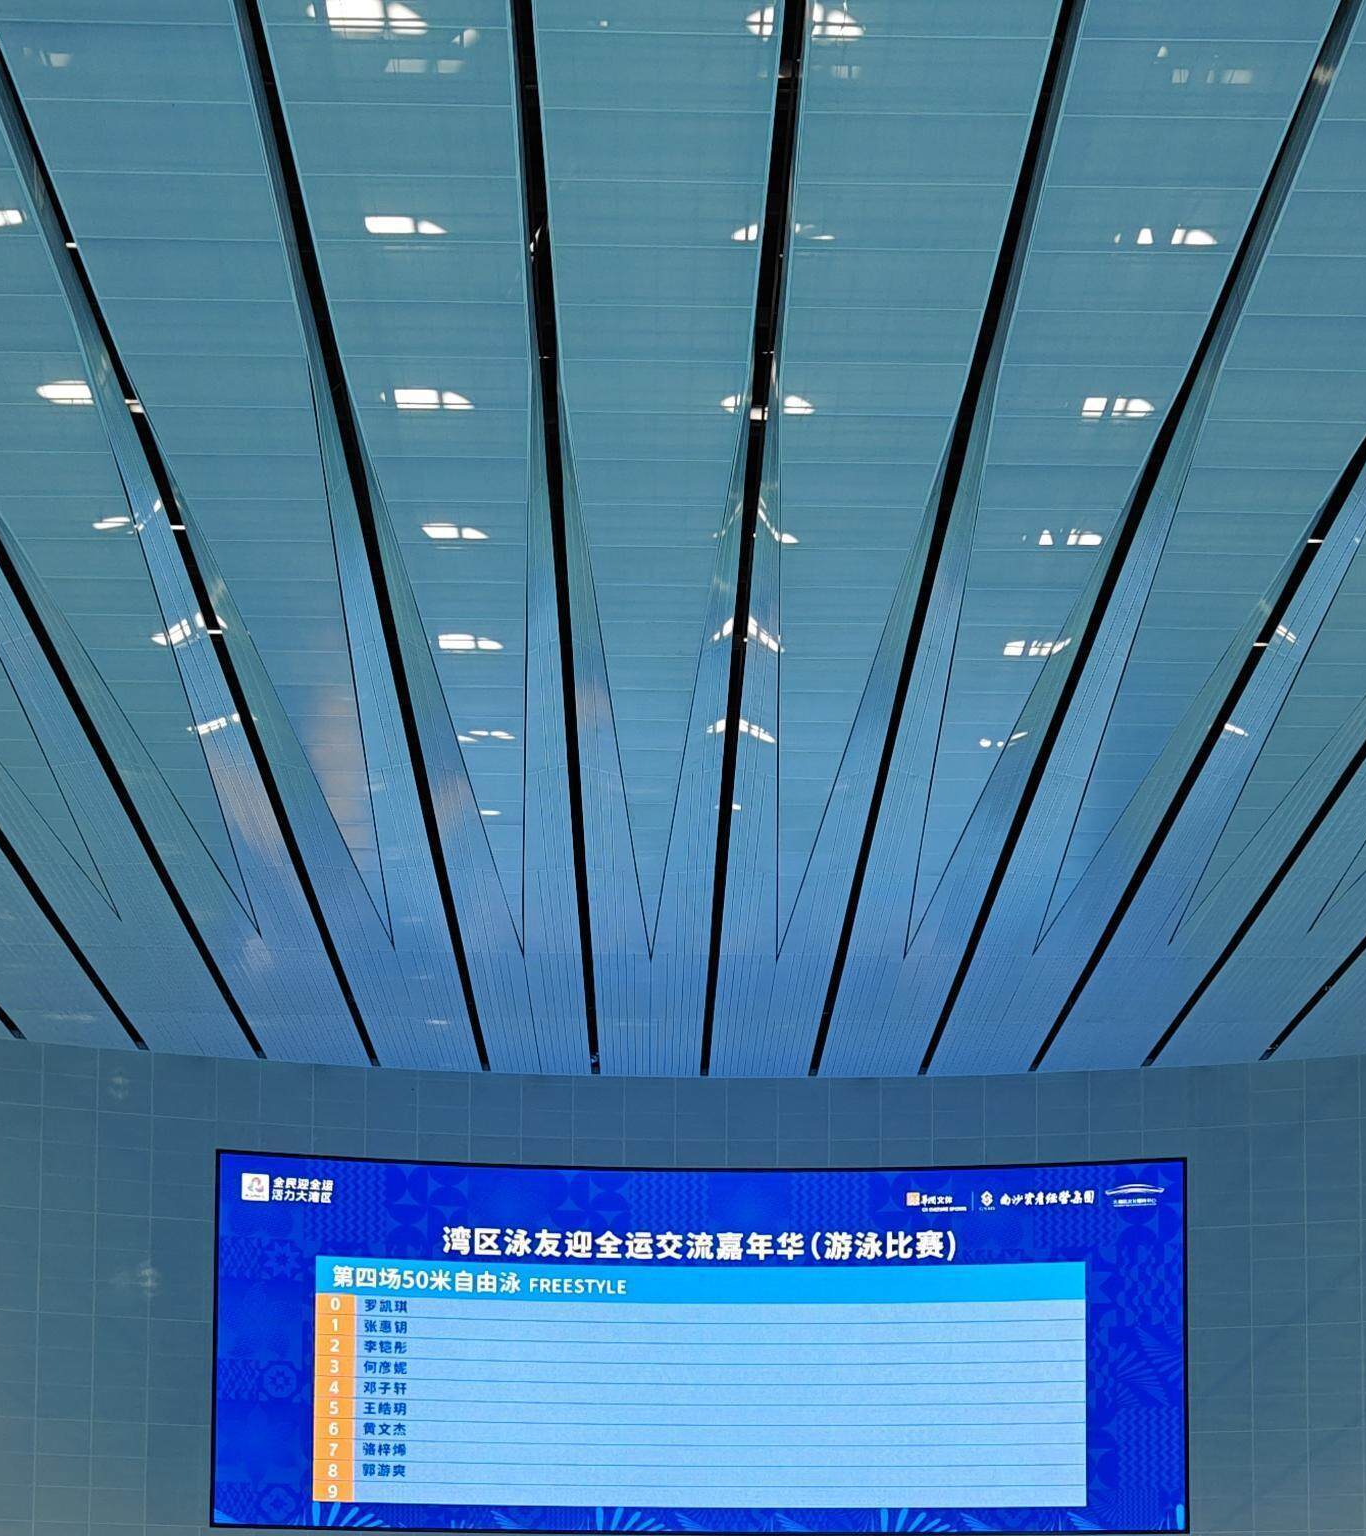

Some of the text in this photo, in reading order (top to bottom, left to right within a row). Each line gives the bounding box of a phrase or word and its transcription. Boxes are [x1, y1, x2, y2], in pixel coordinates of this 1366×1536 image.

[273, 1176, 334, 1191] 全民迎全运
[272, 1189, 332, 1204] 活力大湾区
[442, 1226, 957, 1262] 湾区泳友迎全运交流嘉年华（游泳比赛）
[332, 1264, 628, 1295] 第四场50米自由泳 FREESTYLE
[330, 1297, 341, 1311] 0
[331, 1318, 339, 1332] 1
[329, 1338, 340, 1352] 2
[329, 1359, 340, 1374] 3
[328, 1380, 407, 1395] 4 邓子轩
[328, 1401, 339, 1415] 5
[328, 1422, 407, 1436] 6 黄文杰
[329, 1443, 339, 1457] 7
[327, 1464, 338, 1478] 8
[327, 1485, 338, 1499] 9
